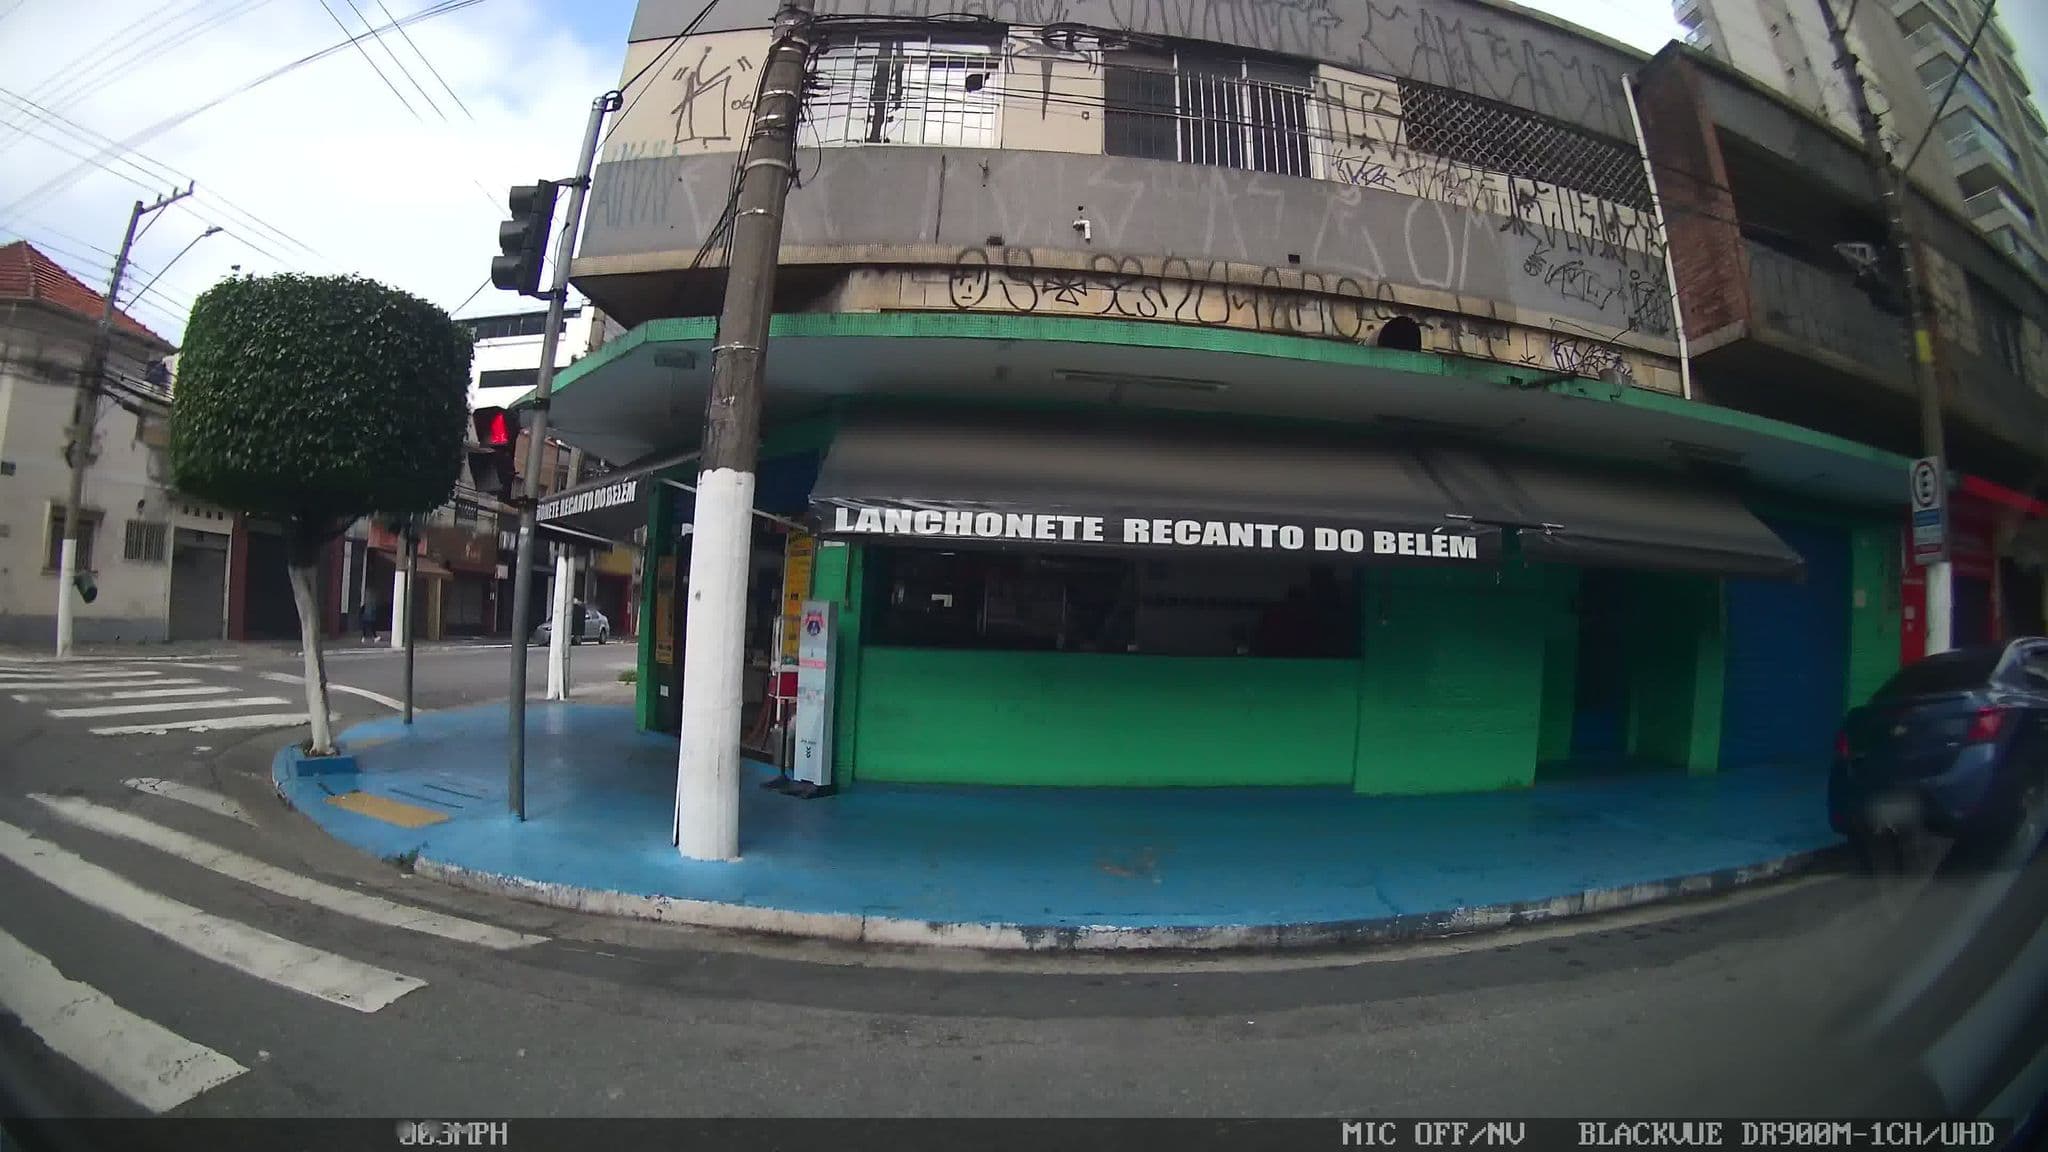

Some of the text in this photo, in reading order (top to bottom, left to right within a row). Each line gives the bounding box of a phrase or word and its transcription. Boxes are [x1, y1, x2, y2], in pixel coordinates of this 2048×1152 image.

[559, 490, 594, 517] RECANTO
[594, 486, 607, 510] DO
[835, 507, 1104, 542] LANCHONETE
[1123, 518, 1304, 550] RECANTO
[1314, 527, 1364, 553] DO
